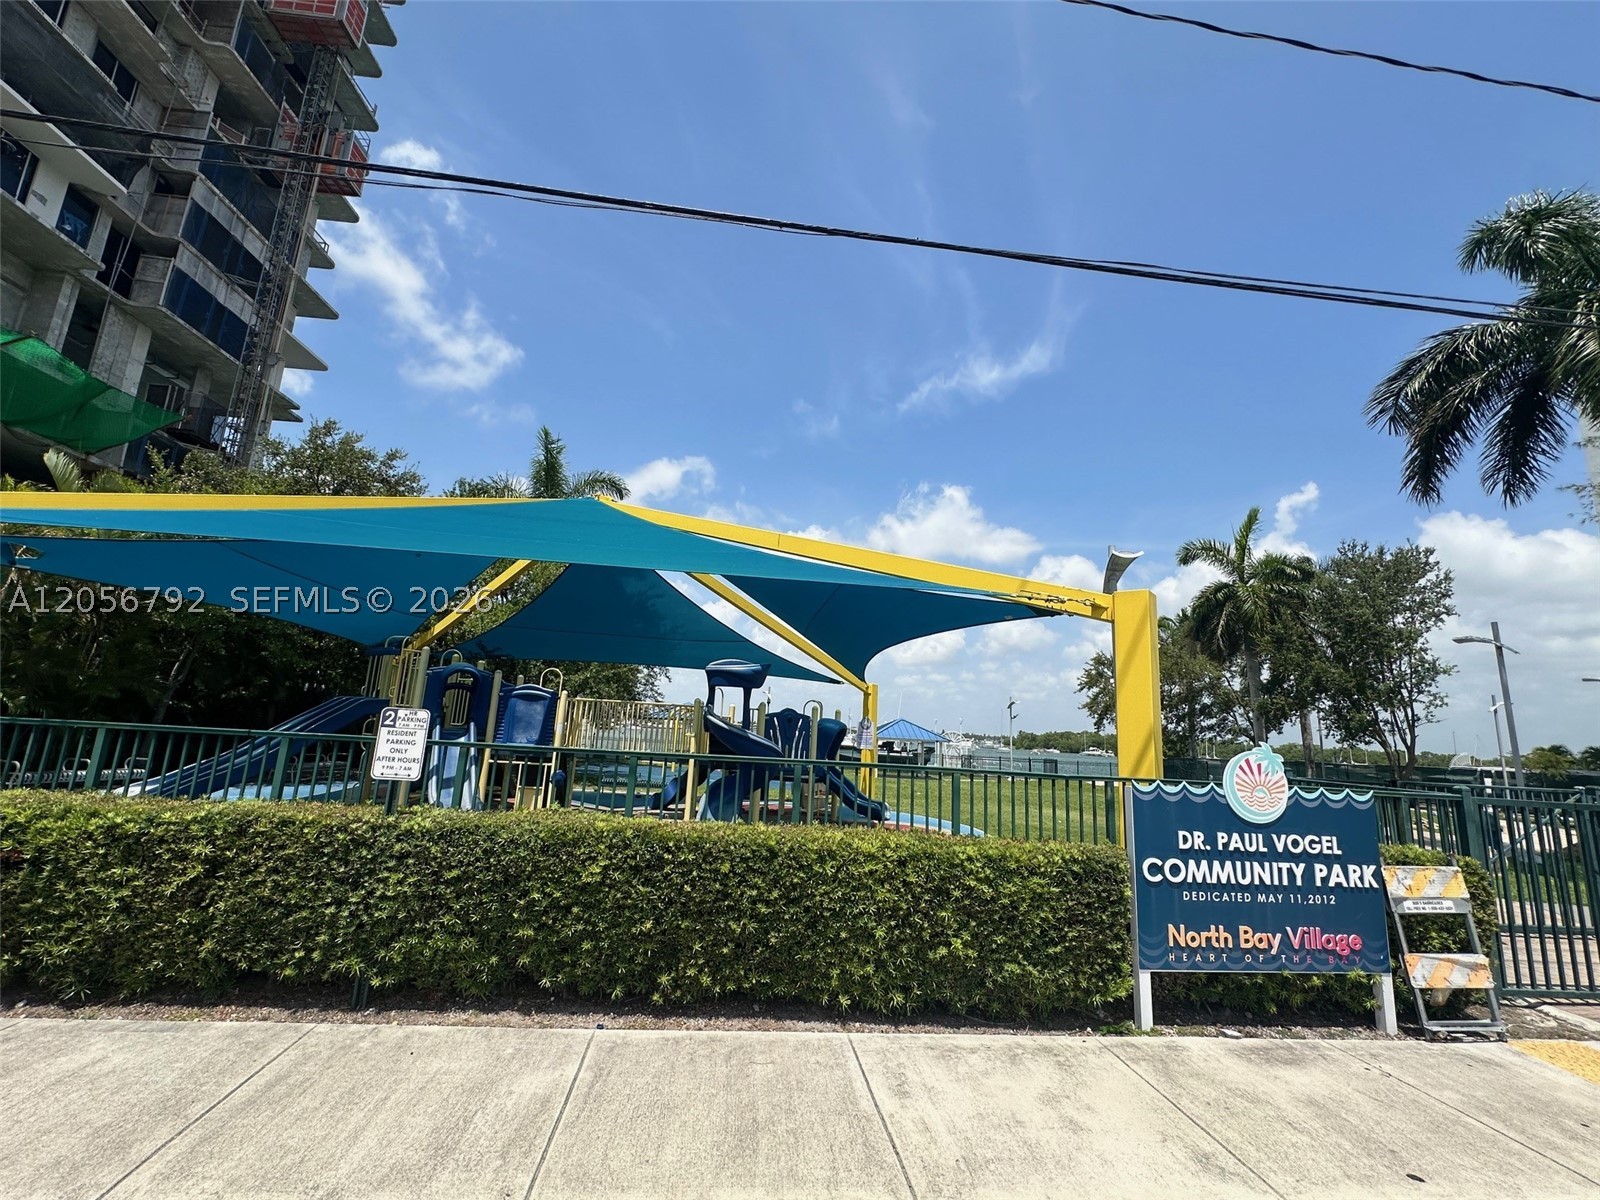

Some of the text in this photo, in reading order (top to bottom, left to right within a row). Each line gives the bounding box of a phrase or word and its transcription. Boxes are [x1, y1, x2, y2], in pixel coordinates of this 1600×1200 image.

[384, 711, 396, 725] 2
[1177, 830, 1343, 855] DR. PAUL VOGEL
[1142, 857, 1379, 889] COMMUNITY PARK
[1183, 890, 1336, 905] DEDICATED MAY 11,2012
[1167, 923, 1363, 956] North Bay Village
[1168, 953, 1361, 964] HEART OF THE BAY
